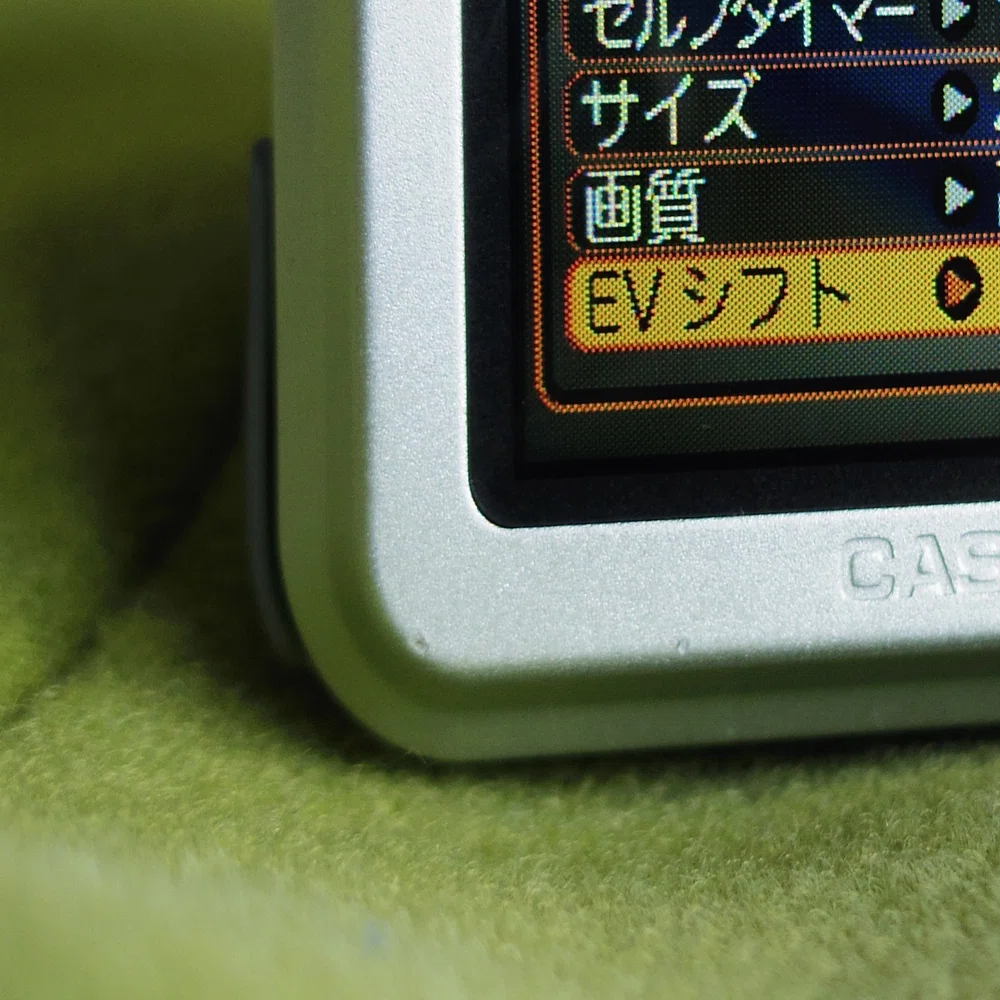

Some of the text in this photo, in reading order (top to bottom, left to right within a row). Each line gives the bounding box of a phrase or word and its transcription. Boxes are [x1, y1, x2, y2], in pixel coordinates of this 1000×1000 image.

[580, 66, 762, 150] サイズ
[584, 168, 707, 245] 画質
